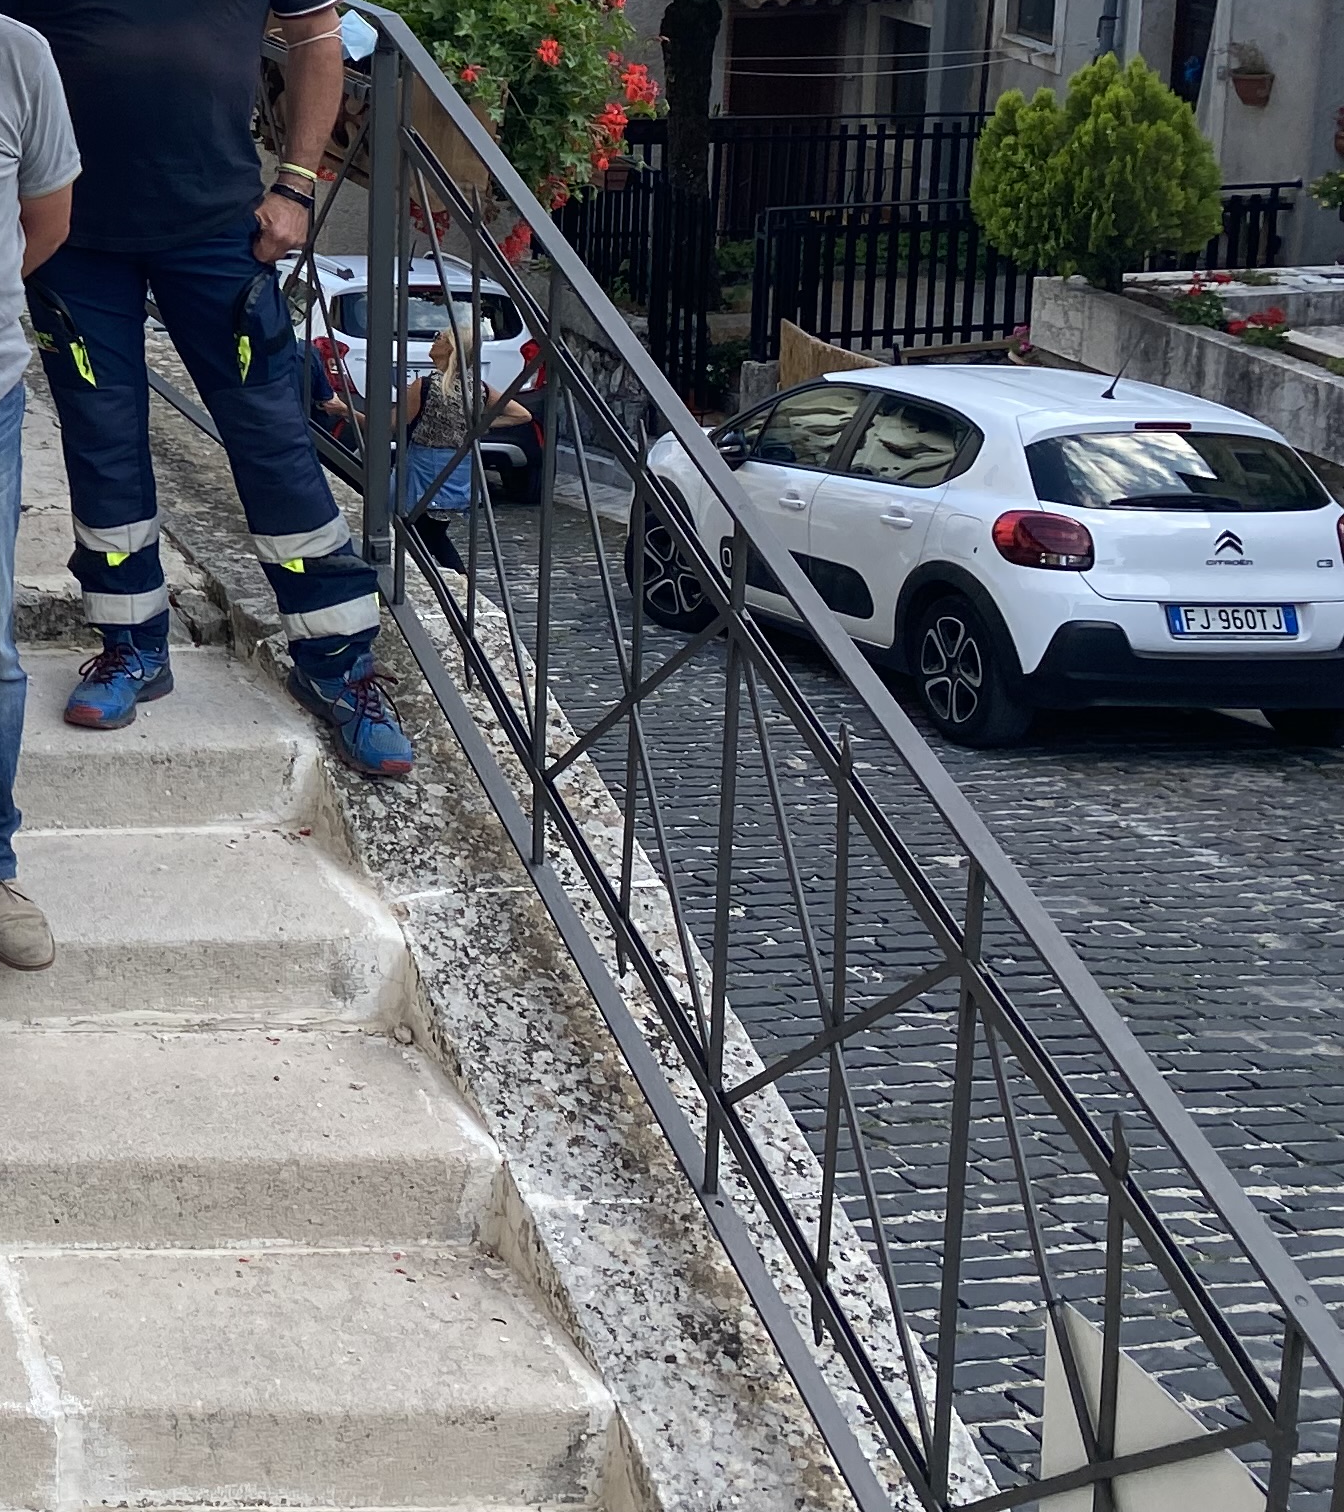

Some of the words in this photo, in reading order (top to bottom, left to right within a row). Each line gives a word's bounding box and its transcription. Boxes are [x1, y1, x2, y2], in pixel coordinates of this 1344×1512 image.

[1317, 559, 1333, 568] C3
[1183, 608, 1211, 630] FJ
[1218, 608, 1282, 630] 960TJ
